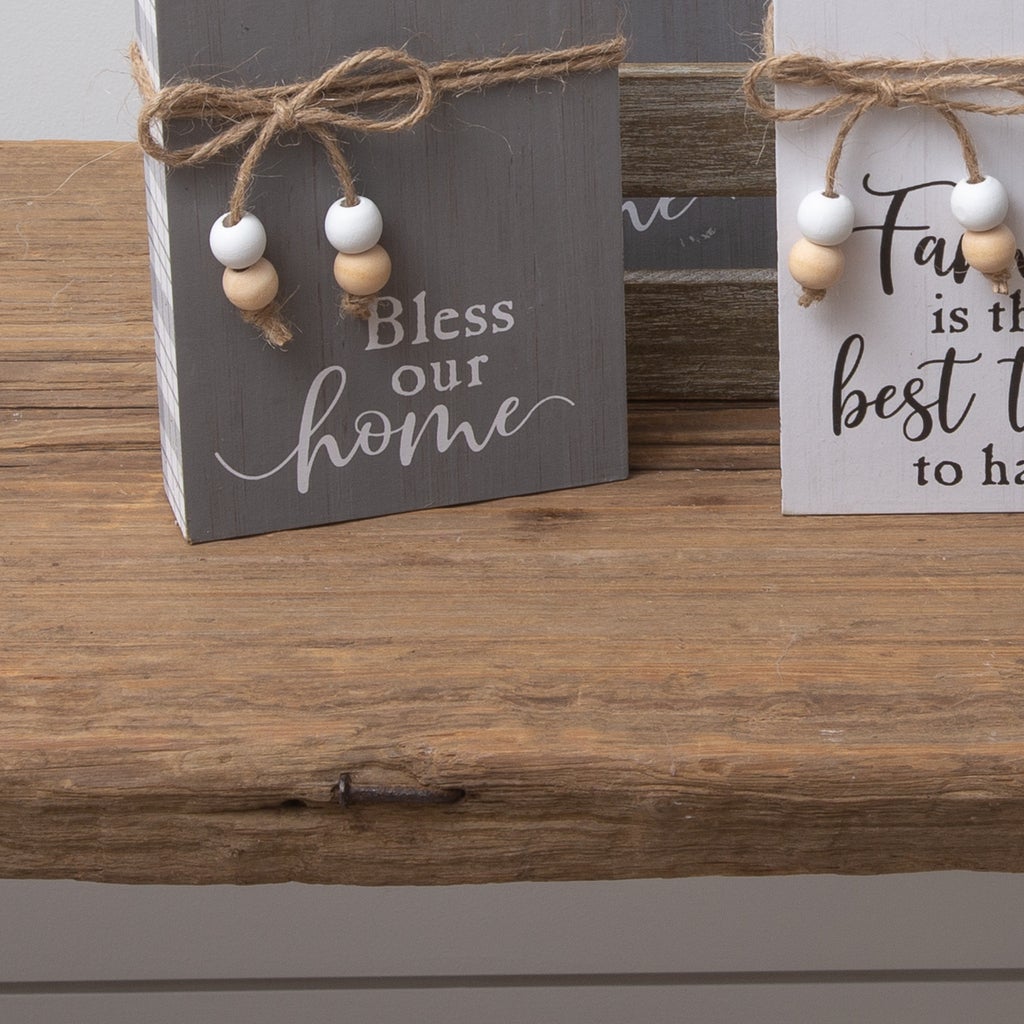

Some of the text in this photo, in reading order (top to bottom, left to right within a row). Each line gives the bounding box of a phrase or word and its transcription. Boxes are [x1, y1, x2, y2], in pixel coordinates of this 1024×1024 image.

[365, 290, 515, 351] Bless
[931, 293, 969, 334] is
[391, 353, 488, 396] our
[832, 333, 983, 442] best
[214, 365, 575, 494] home
[913, 456, 963, 486] to
